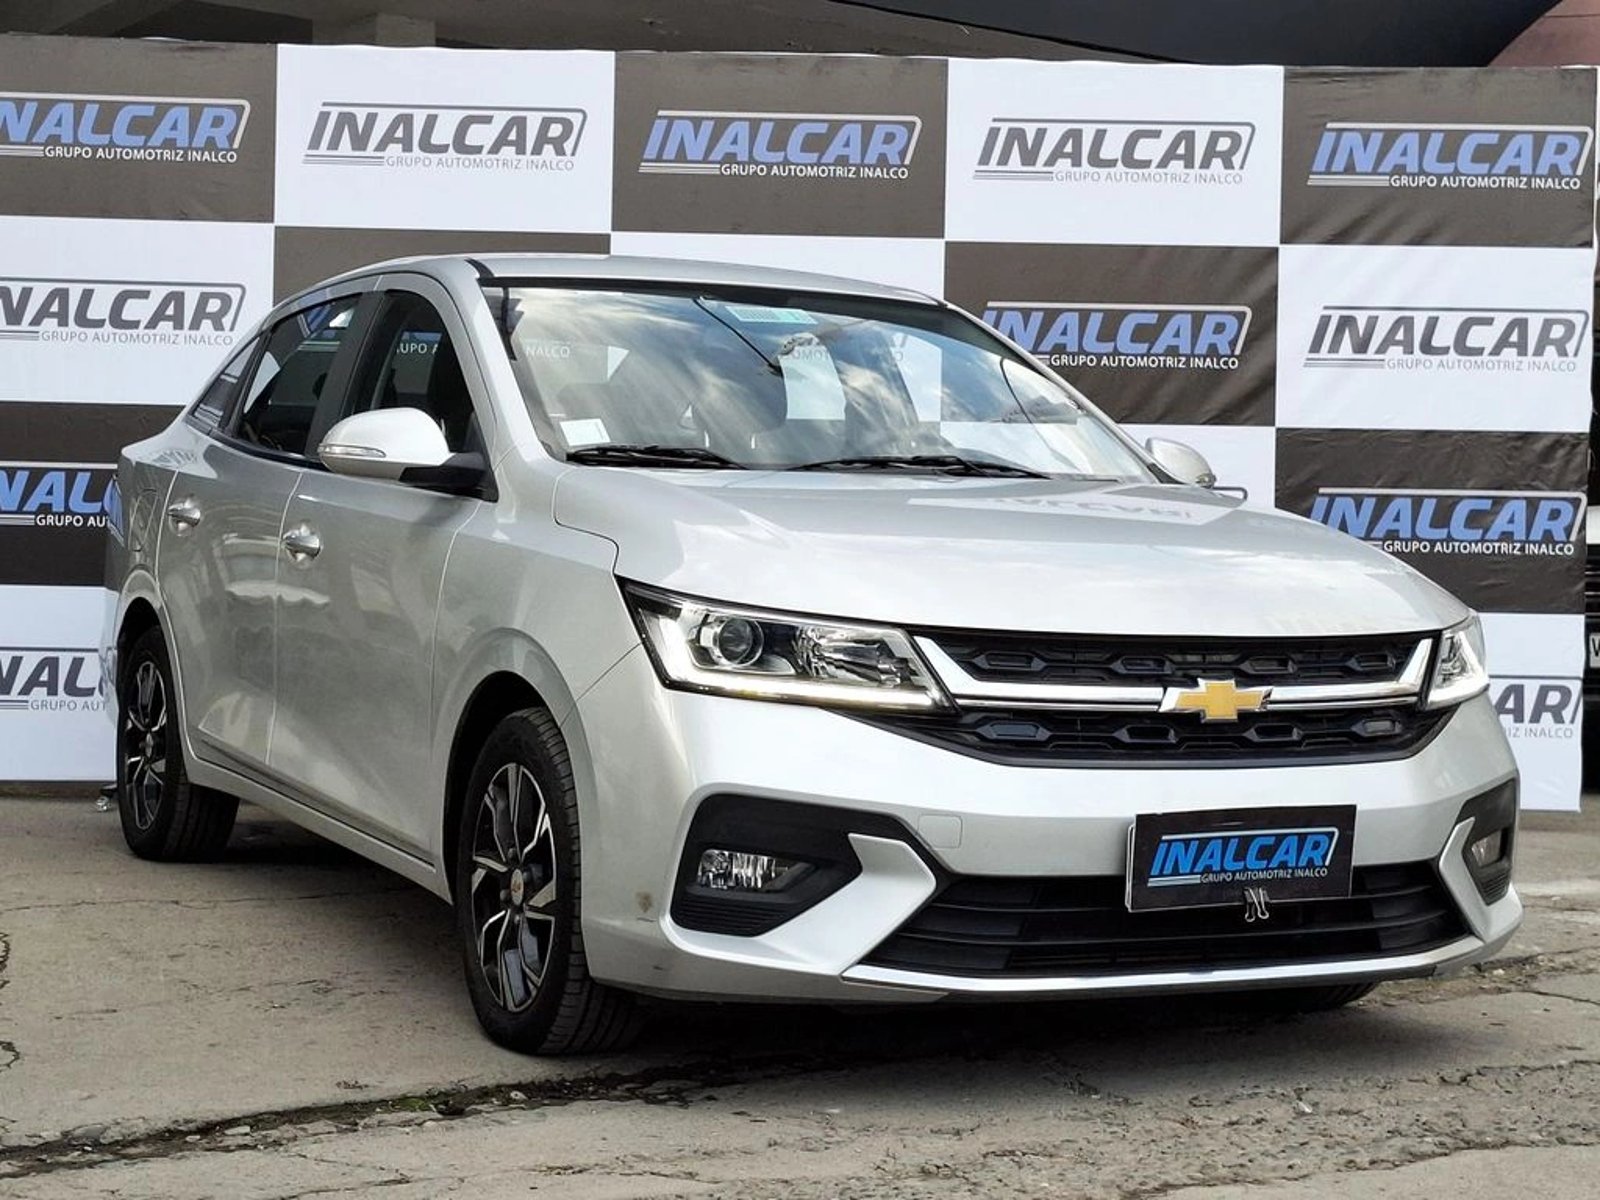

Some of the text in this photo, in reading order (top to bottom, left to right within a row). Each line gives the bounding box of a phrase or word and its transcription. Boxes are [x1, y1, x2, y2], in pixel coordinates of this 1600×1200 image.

[0, 100, 237, 149] NALCAR
[307, 110, 575, 157] INALCAR
[643, 119, 910, 165] INALCAR
[977, 126, 1243, 170] INALCAR
[45, 146, 237, 163] GRUPO AUTOMOTRIZ INALCO
[1312, 131, 1580, 176] INALCAR
[386, 155, 575, 171] GRUPO AUTOMOTRIZ INALCO
[721, 163, 909, 179] GRUPO AUTOMOTRIZ INALCO
[1055, 170, 1243, 185] GRUPO AUTOMOTRIZ INALCO
[1390, 175, 1581, 190] GRUPO AUTOMOTRIZ INALCO
[0, 286, 232, 331] NALCAR
[41, 330, 233, 346] GRUPO AUTOMOTRIZ INALCO
[1308, 314, 1576, 358] INALCAR
[1051, 354, 1239, 369] GRUPO AUTOMOTRIZ INALCO
[1386, 358, 1576, 372] GRUPO AUTOMOTRIZ INALCO
[36, 514, 84, 527] GRUPO
[1384, 540, 1575, 556] GRUPO AUTOMOTRIZ INALCO
[30, 699, 78, 711] GRUPO
[1525, 727, 1573, 738] INALCO
[1150, 833, 1330, 876] INALCAR
[1201, 867, 1329, 884] GRUPO AUTOMOTRIZ INALCO
